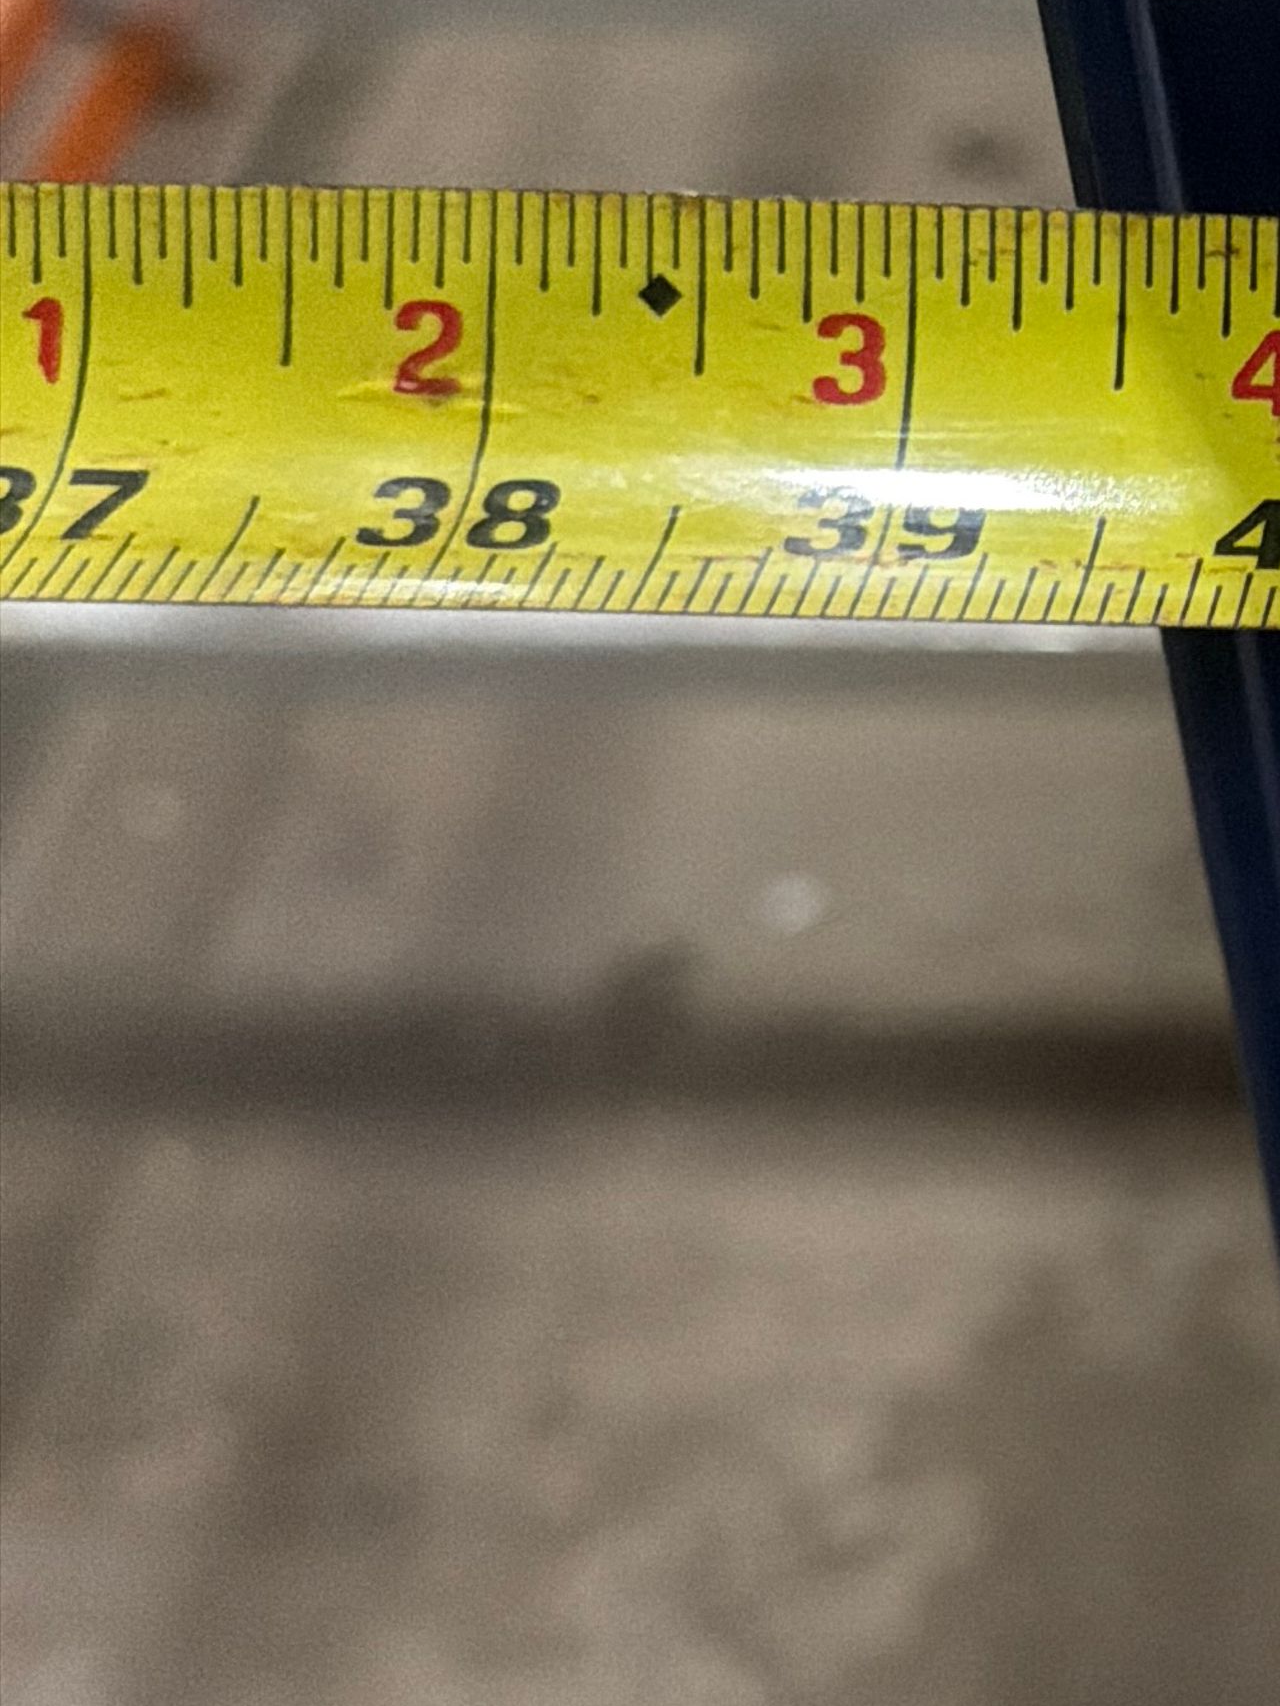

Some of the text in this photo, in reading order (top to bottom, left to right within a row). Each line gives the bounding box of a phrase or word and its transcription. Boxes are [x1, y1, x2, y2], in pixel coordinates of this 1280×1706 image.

[22, 297, 63, 384] 1
[393, 300, 462, 394] 2
[811, 313, 886, 406] 3
[354, 475, 561, 549] 38
[782, 485, 986, 561] 39
